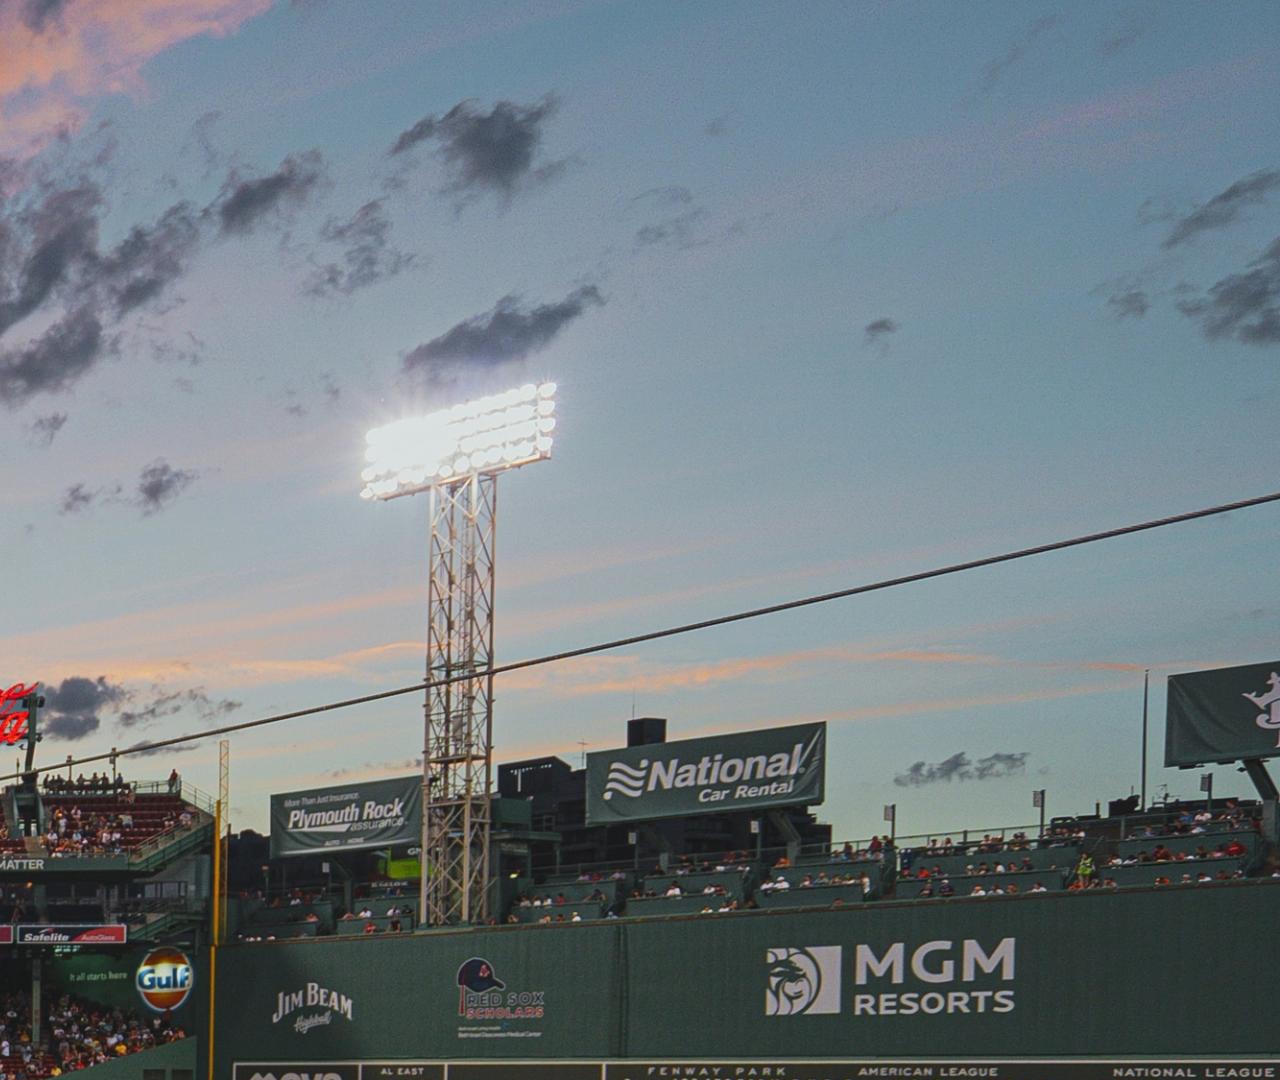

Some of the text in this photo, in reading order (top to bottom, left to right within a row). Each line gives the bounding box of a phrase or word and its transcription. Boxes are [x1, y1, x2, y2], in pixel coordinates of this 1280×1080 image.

[647, 743, 803, 791] National
[698, 779, 794, 803] Car Rental
[288, 798, 405, 829] Plymouth Rock
[24, 932, 69, 942] Safelite
[855, 937, 1016, 985] MGM
[76, 973, 86, 982] all
[87, 972, 107, 981] starts
[108, 971, 128, 980] here
[138, 966, 189, 990] Gulf
[272, 982, 353, 1023] JIM BEAM
[465, 991, 545, 1006] RED SOX
[854, 990, 1015, 1015] RESORTS
[466, 1007, 544, 1019] SCHOLARS
[381, 1067, 424, 1075] AL EAST
[647, 1066, 786, 1076] FENWAY PARK
[858, 1068, 998, 1077] AMERICAN LEAGUE
[1113, 1068, 1275, 1078] NATIONAL LEAGUE
